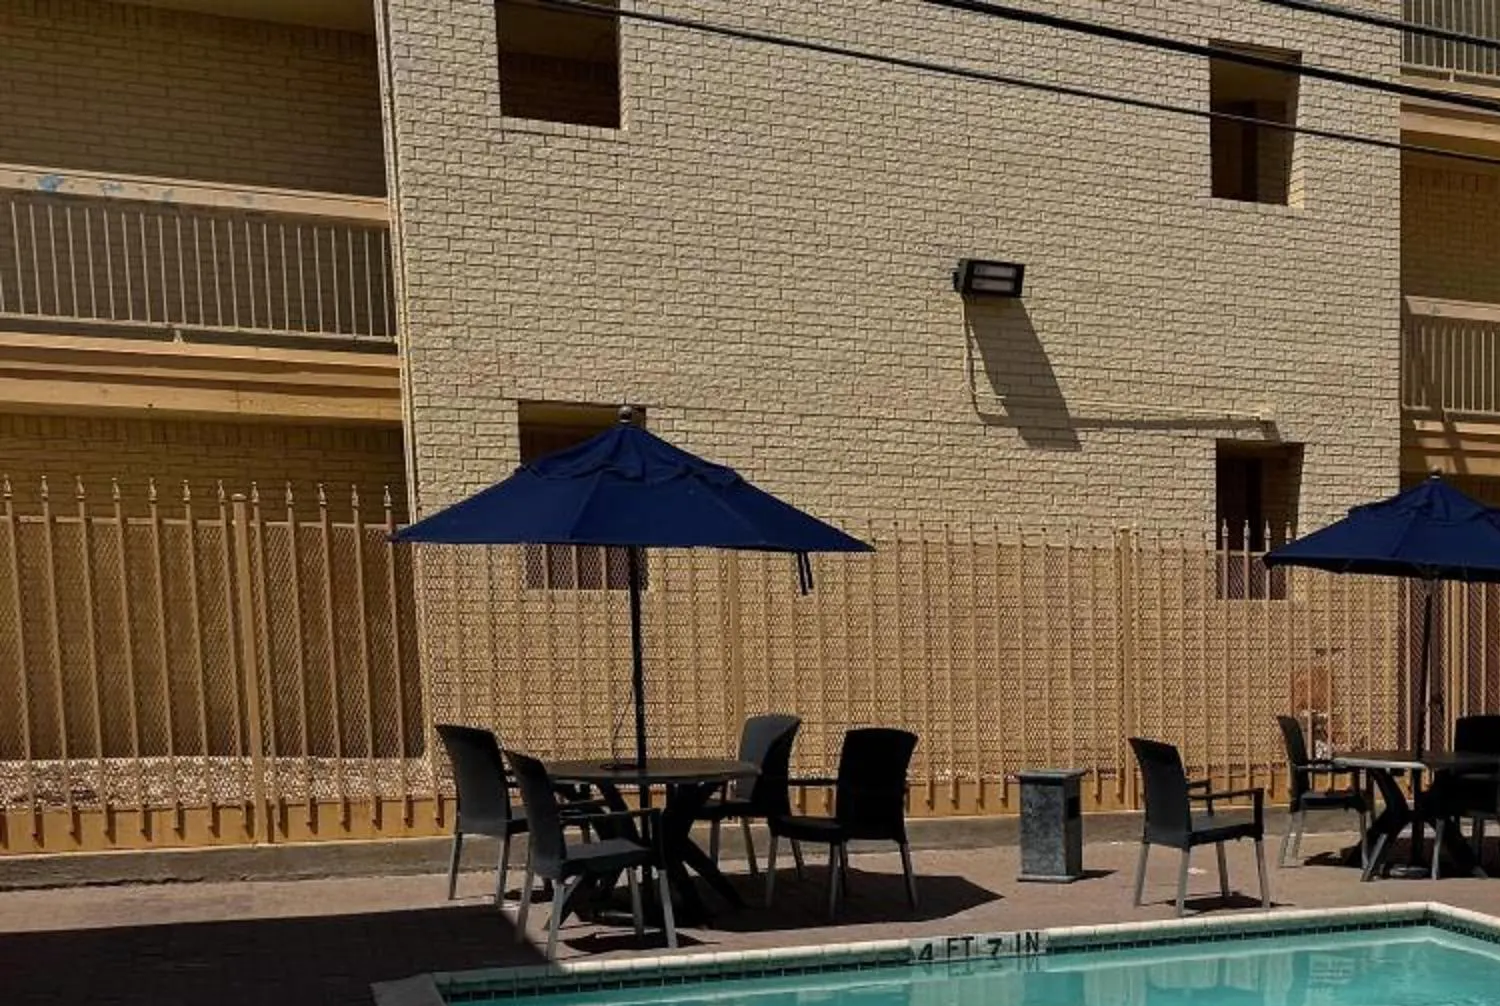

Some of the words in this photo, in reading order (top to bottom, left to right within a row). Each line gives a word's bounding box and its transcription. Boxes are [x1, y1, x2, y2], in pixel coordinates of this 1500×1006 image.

[918, 942, 933, 961] 4
[947, 936, 975, 958] FT
[987, 937, 1002, 956] 7
[1015, 931, 1040, 953] IN
